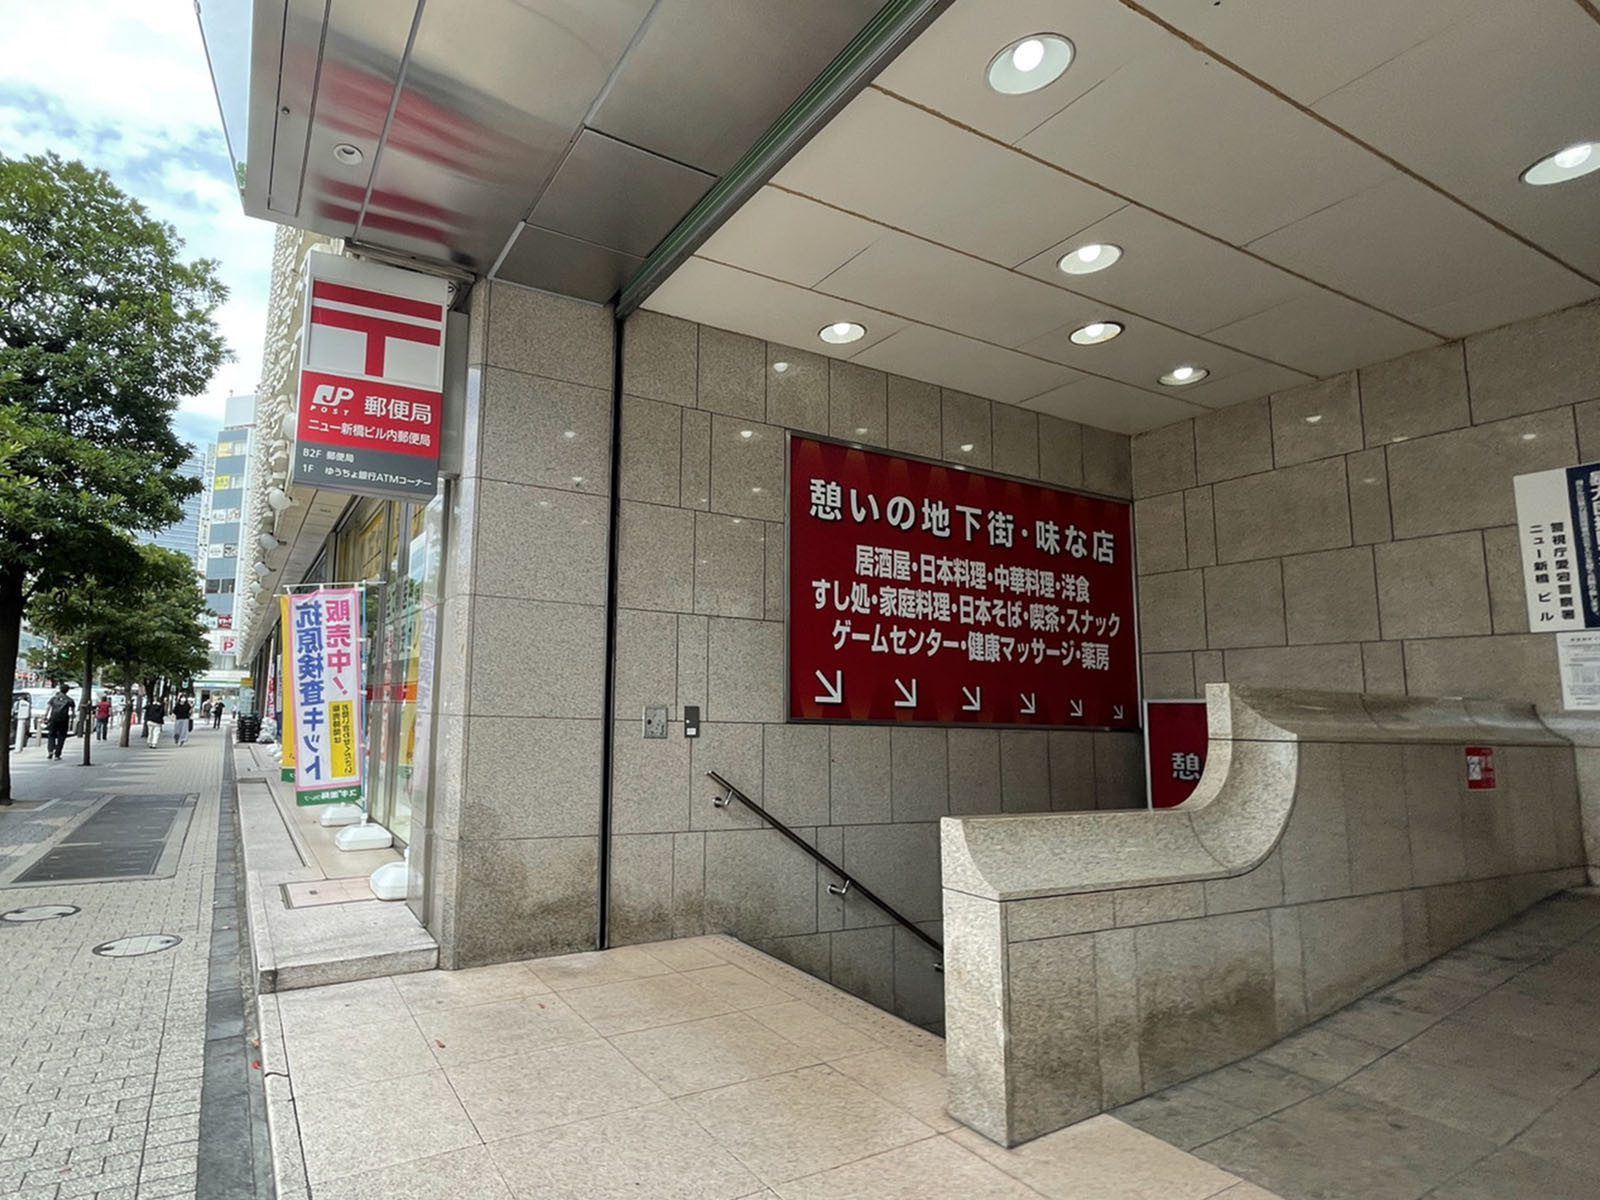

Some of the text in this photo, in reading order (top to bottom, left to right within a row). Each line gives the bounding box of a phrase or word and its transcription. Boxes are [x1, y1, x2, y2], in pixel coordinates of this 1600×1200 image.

[309, 405, 350, 416] POST
[363, 396, 432, 425] 郵便局
[308, 419, 431, 447] ニュー新橋ビル内郵便局
[302, 448, 354, 463] B2F 郵便局
[302, 464, 432, 487] 1F ゆうちょ銀行ATMコーナー
[809, 478, 1115, 564] 憩いの地下街・味な店
[855, 544, 1091, 603] 居酒屋・日本料理・中華料理・洋食
[1171, 752, 1200, 781] 憩
